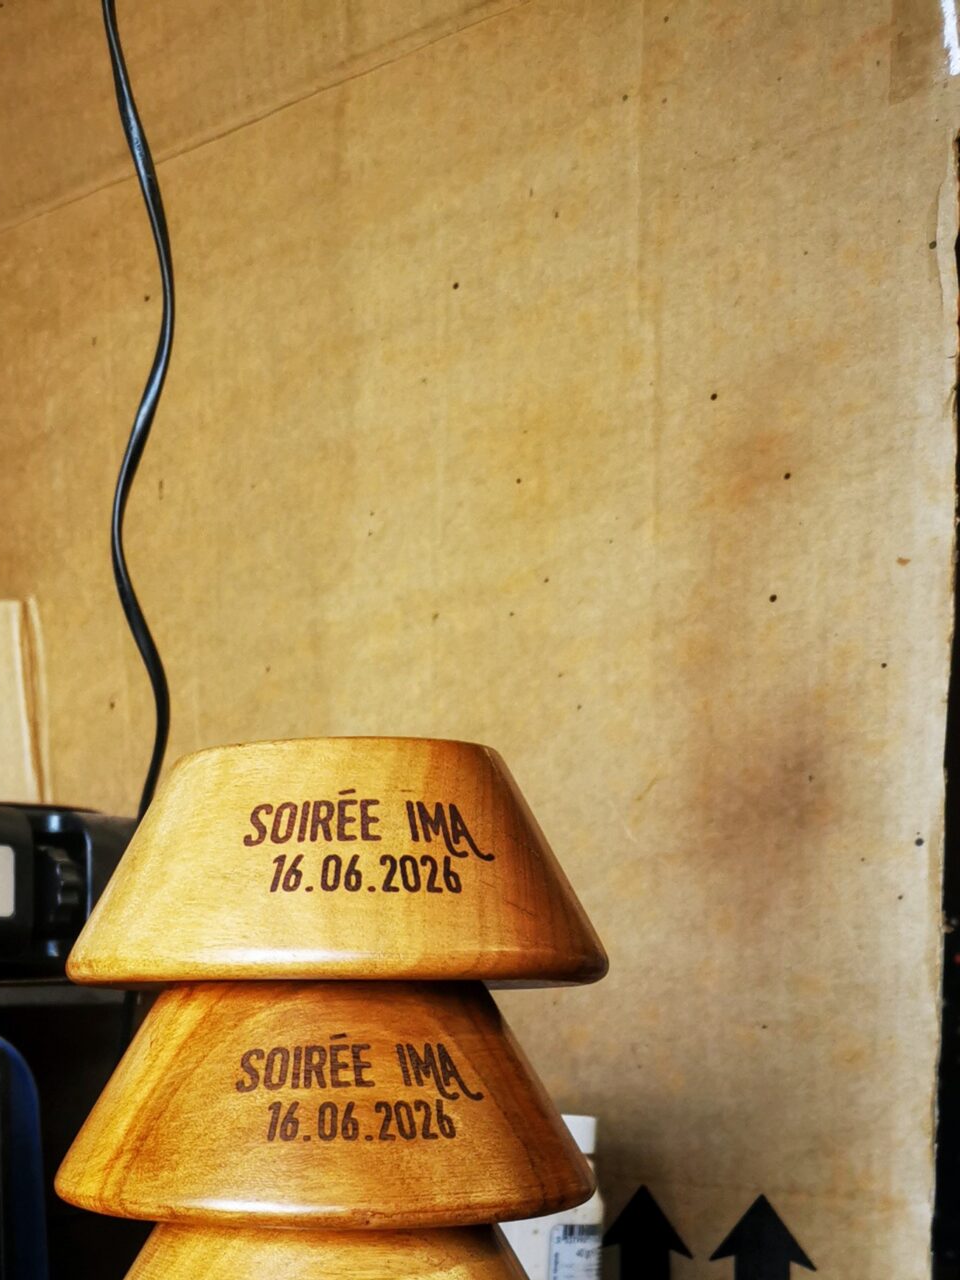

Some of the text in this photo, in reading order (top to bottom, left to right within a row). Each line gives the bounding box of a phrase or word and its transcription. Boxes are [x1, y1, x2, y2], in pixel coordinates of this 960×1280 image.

[243, 789, 494, 861] SOIRÉE IMA
[270, 854, 462, 893] 16.06.2026
[236, 1034, 484, 1100] SOIRÉE IMA
[267, 1100, 456, 1142] 16.06.2026
